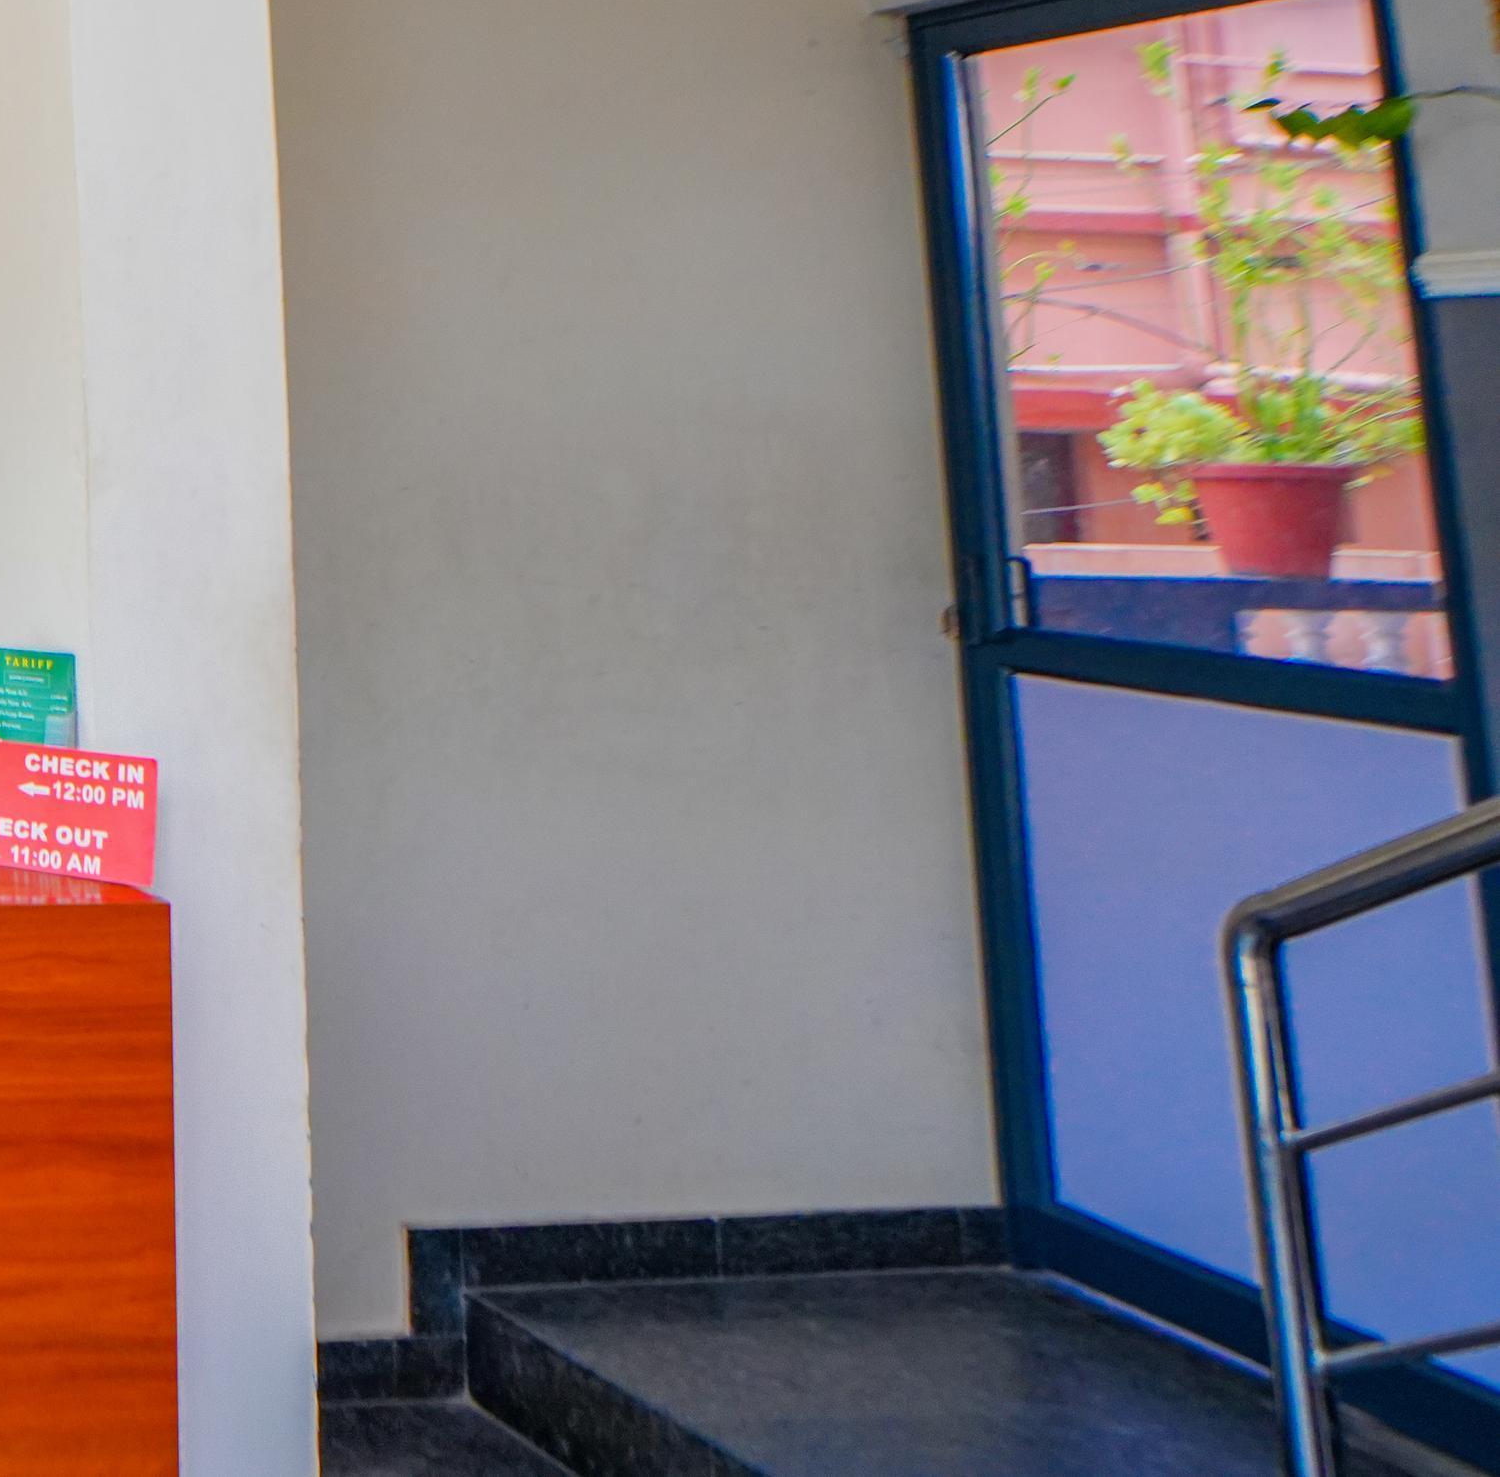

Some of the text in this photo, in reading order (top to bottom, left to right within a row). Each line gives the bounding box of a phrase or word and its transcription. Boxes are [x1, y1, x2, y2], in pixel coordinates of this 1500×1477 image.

[5, 655, 54, 671] TARIFF
[24, 753, 145, 784] CHECK IN
[52, 781, 145, 810] 12:00 PM
[55, 826, 109, 850] OUT
[10, 845, 101, 875] 11:00 AM
